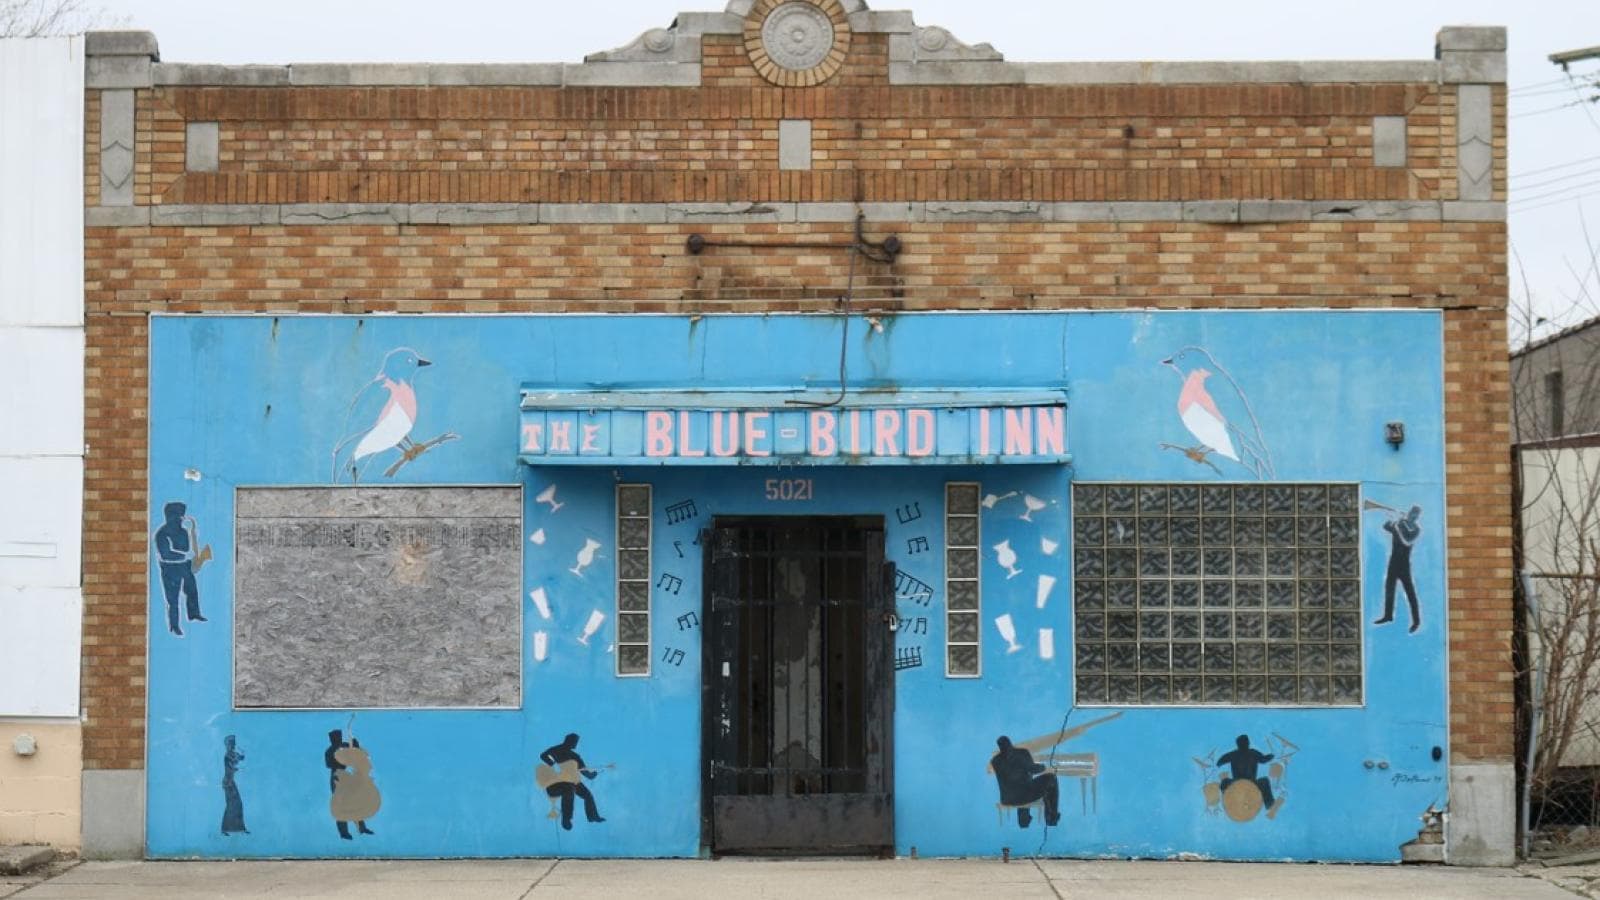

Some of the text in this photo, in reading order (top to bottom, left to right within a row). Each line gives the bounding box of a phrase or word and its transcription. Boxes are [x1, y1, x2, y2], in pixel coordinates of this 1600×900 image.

[522, 406, 1065, 457] THE BLUE-BIRD INN
[765, 478, 813, 500] 5021
